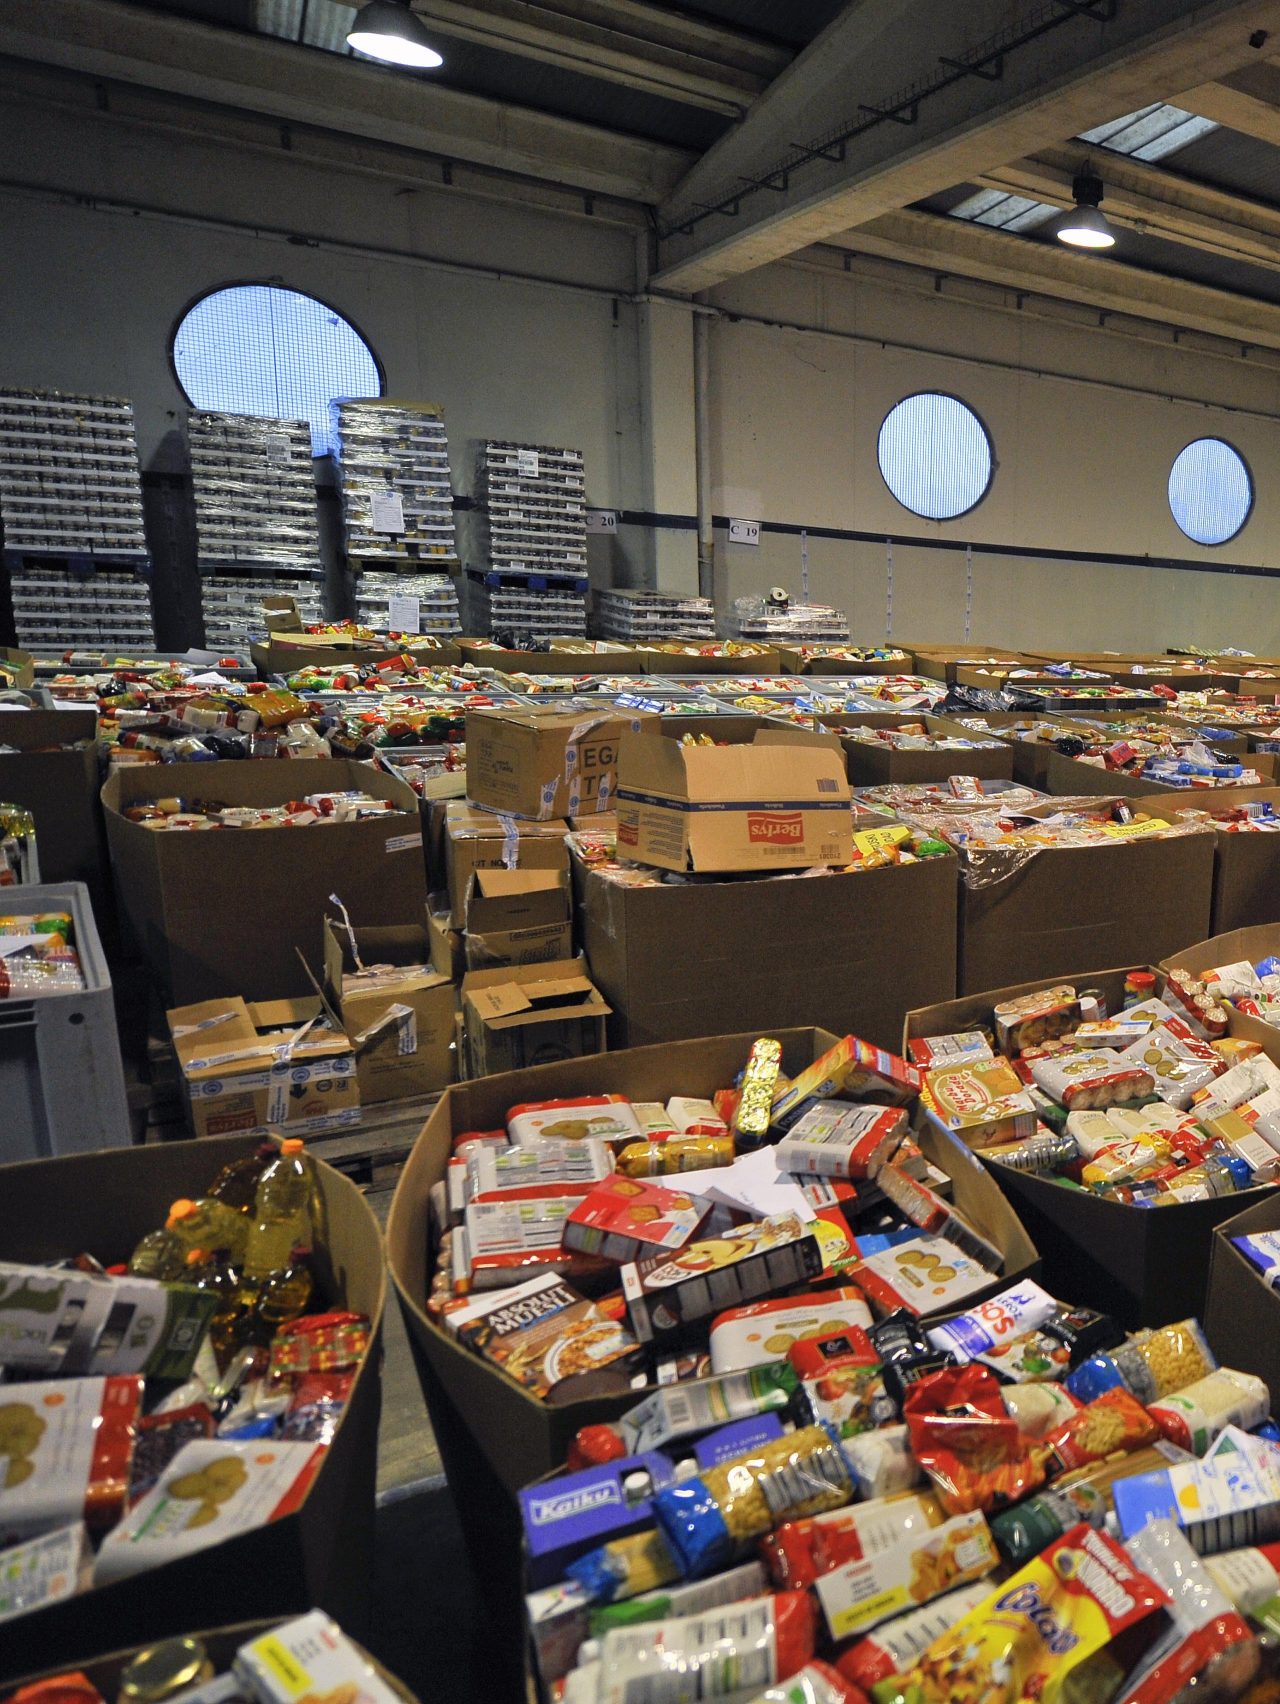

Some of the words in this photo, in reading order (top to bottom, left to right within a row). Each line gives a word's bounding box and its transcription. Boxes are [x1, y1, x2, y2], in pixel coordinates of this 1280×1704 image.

[601, 516, 614, 526] 20
[730, 525, 740, 535] C
[745, 527, 758, 537] 19
[751, 819, 801, 838] Berlys
[945, 1087, 971, 1112] Marbu
[948, 1075, 977, 1105] Dorada
[488, 1285, 570, 1327] ABSOLUT
[495, 1292, 577, 1335] MUESLI
[973, 1301, 1015, 1335] SOS
[540, 1487, 611, 1518] Kaiku
